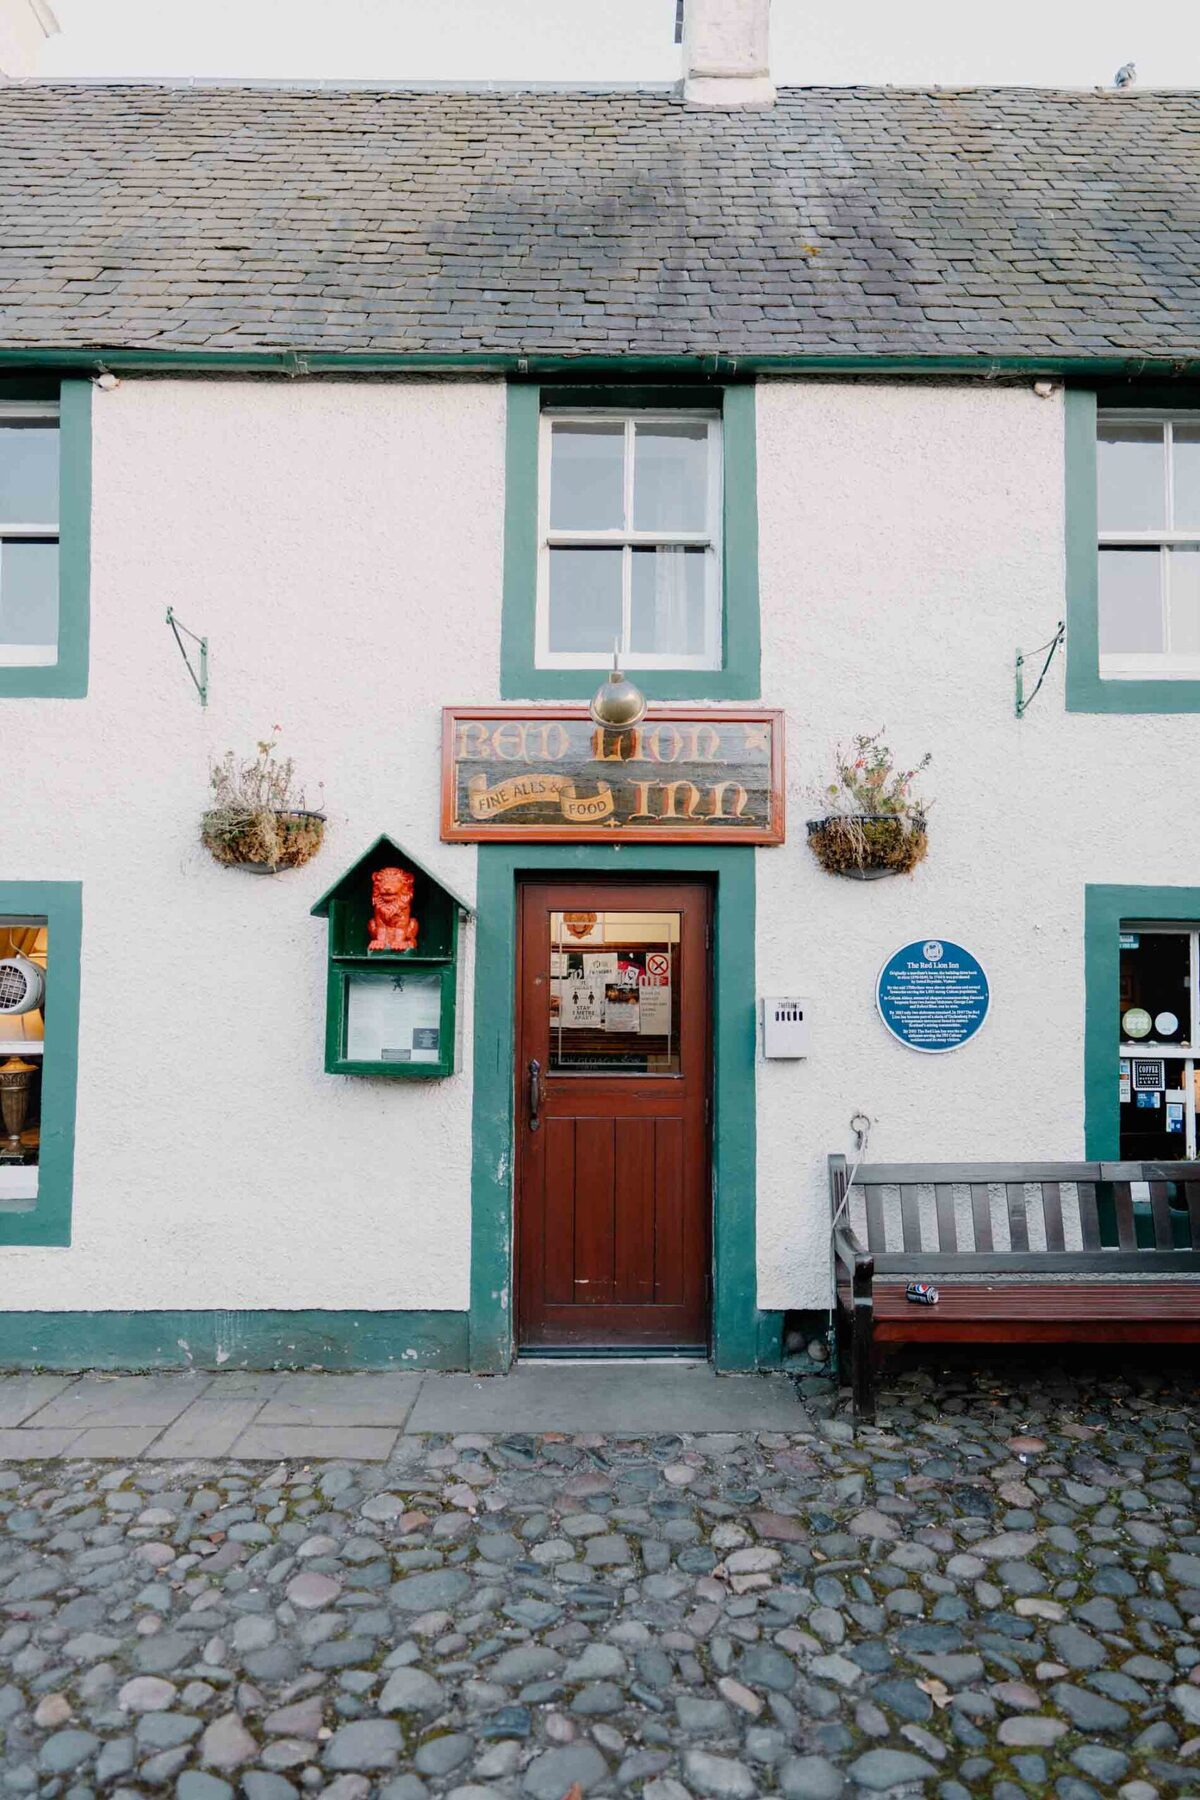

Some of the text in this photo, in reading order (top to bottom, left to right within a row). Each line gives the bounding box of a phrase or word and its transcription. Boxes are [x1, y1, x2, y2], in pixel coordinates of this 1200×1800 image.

[456, 722, 569, 764] RED
[478, 789, 509, 811] FINE
[568, 800, 607, 815] FOOD
[1138, 1065, 1159, 1074] COFFEE
